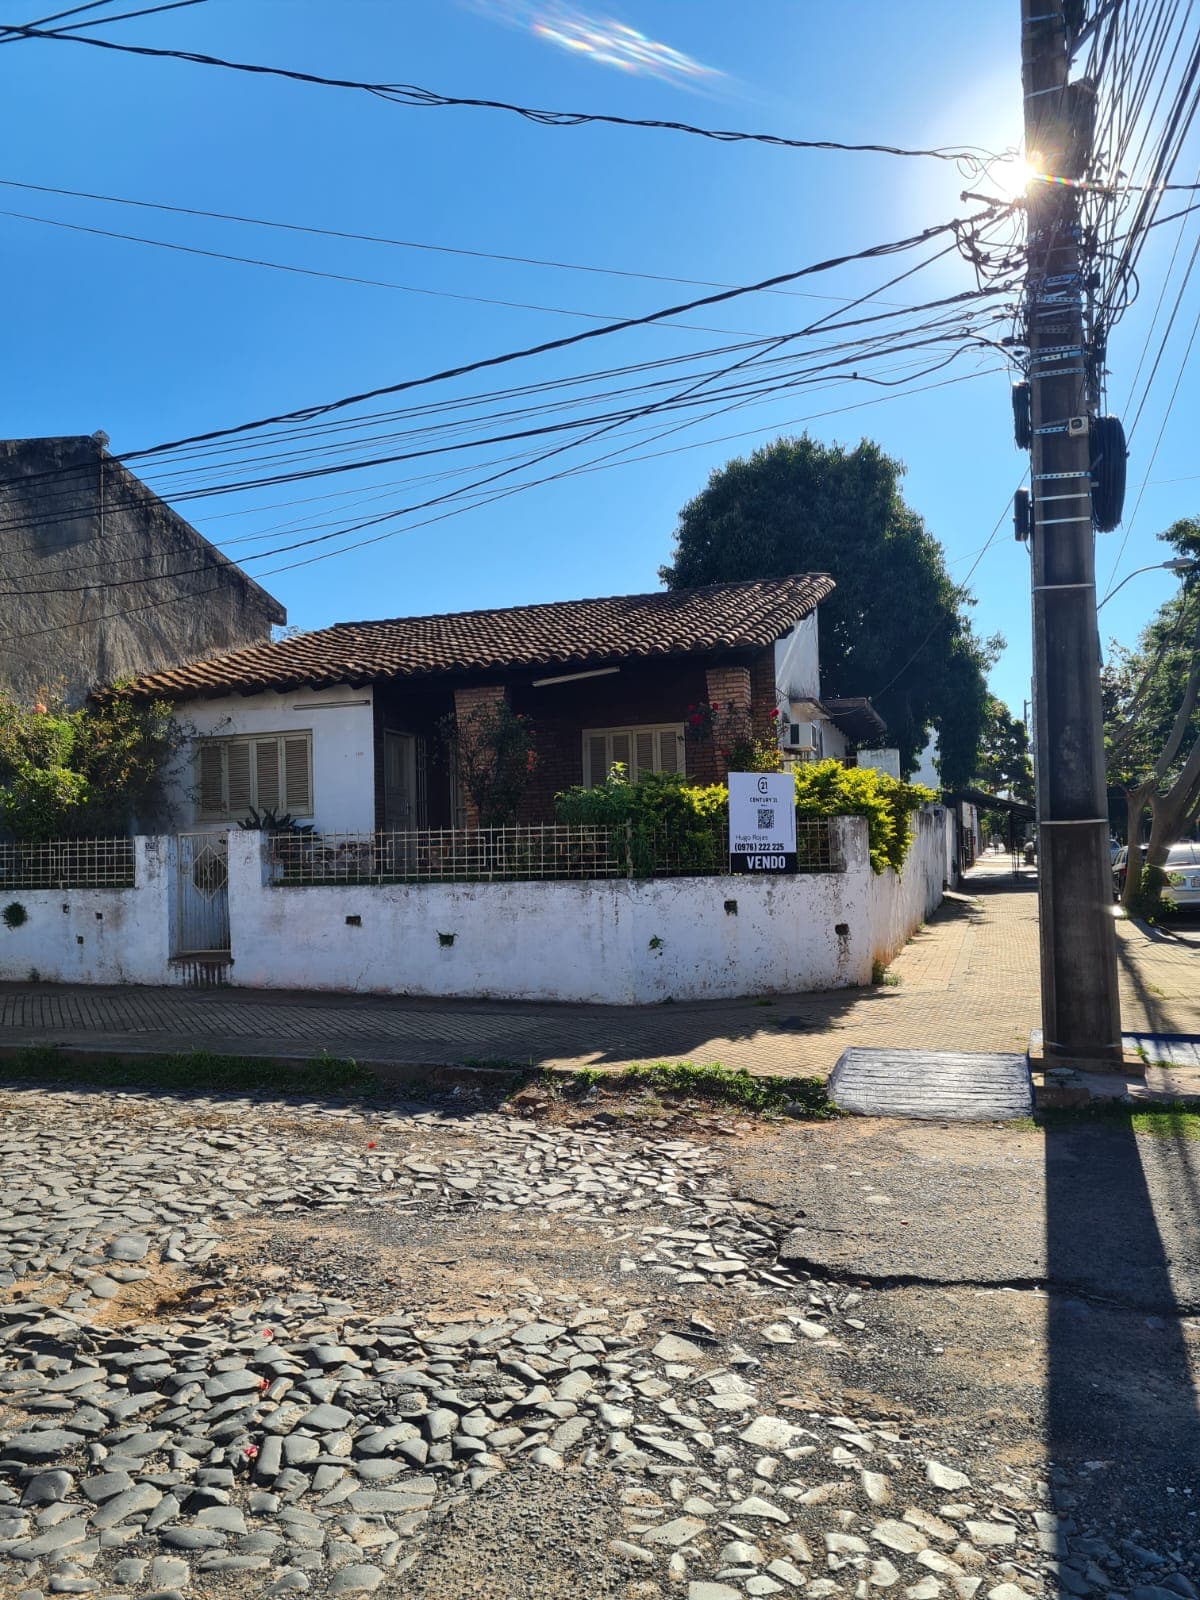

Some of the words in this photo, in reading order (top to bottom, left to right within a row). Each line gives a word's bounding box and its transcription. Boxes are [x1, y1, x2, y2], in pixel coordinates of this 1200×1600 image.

[735, 834, 751, 842] Hugo
[758, 842, 770, 850] 222
[771, 842, 784, 850] 225
[746, 855, 786, 869] VENDO
